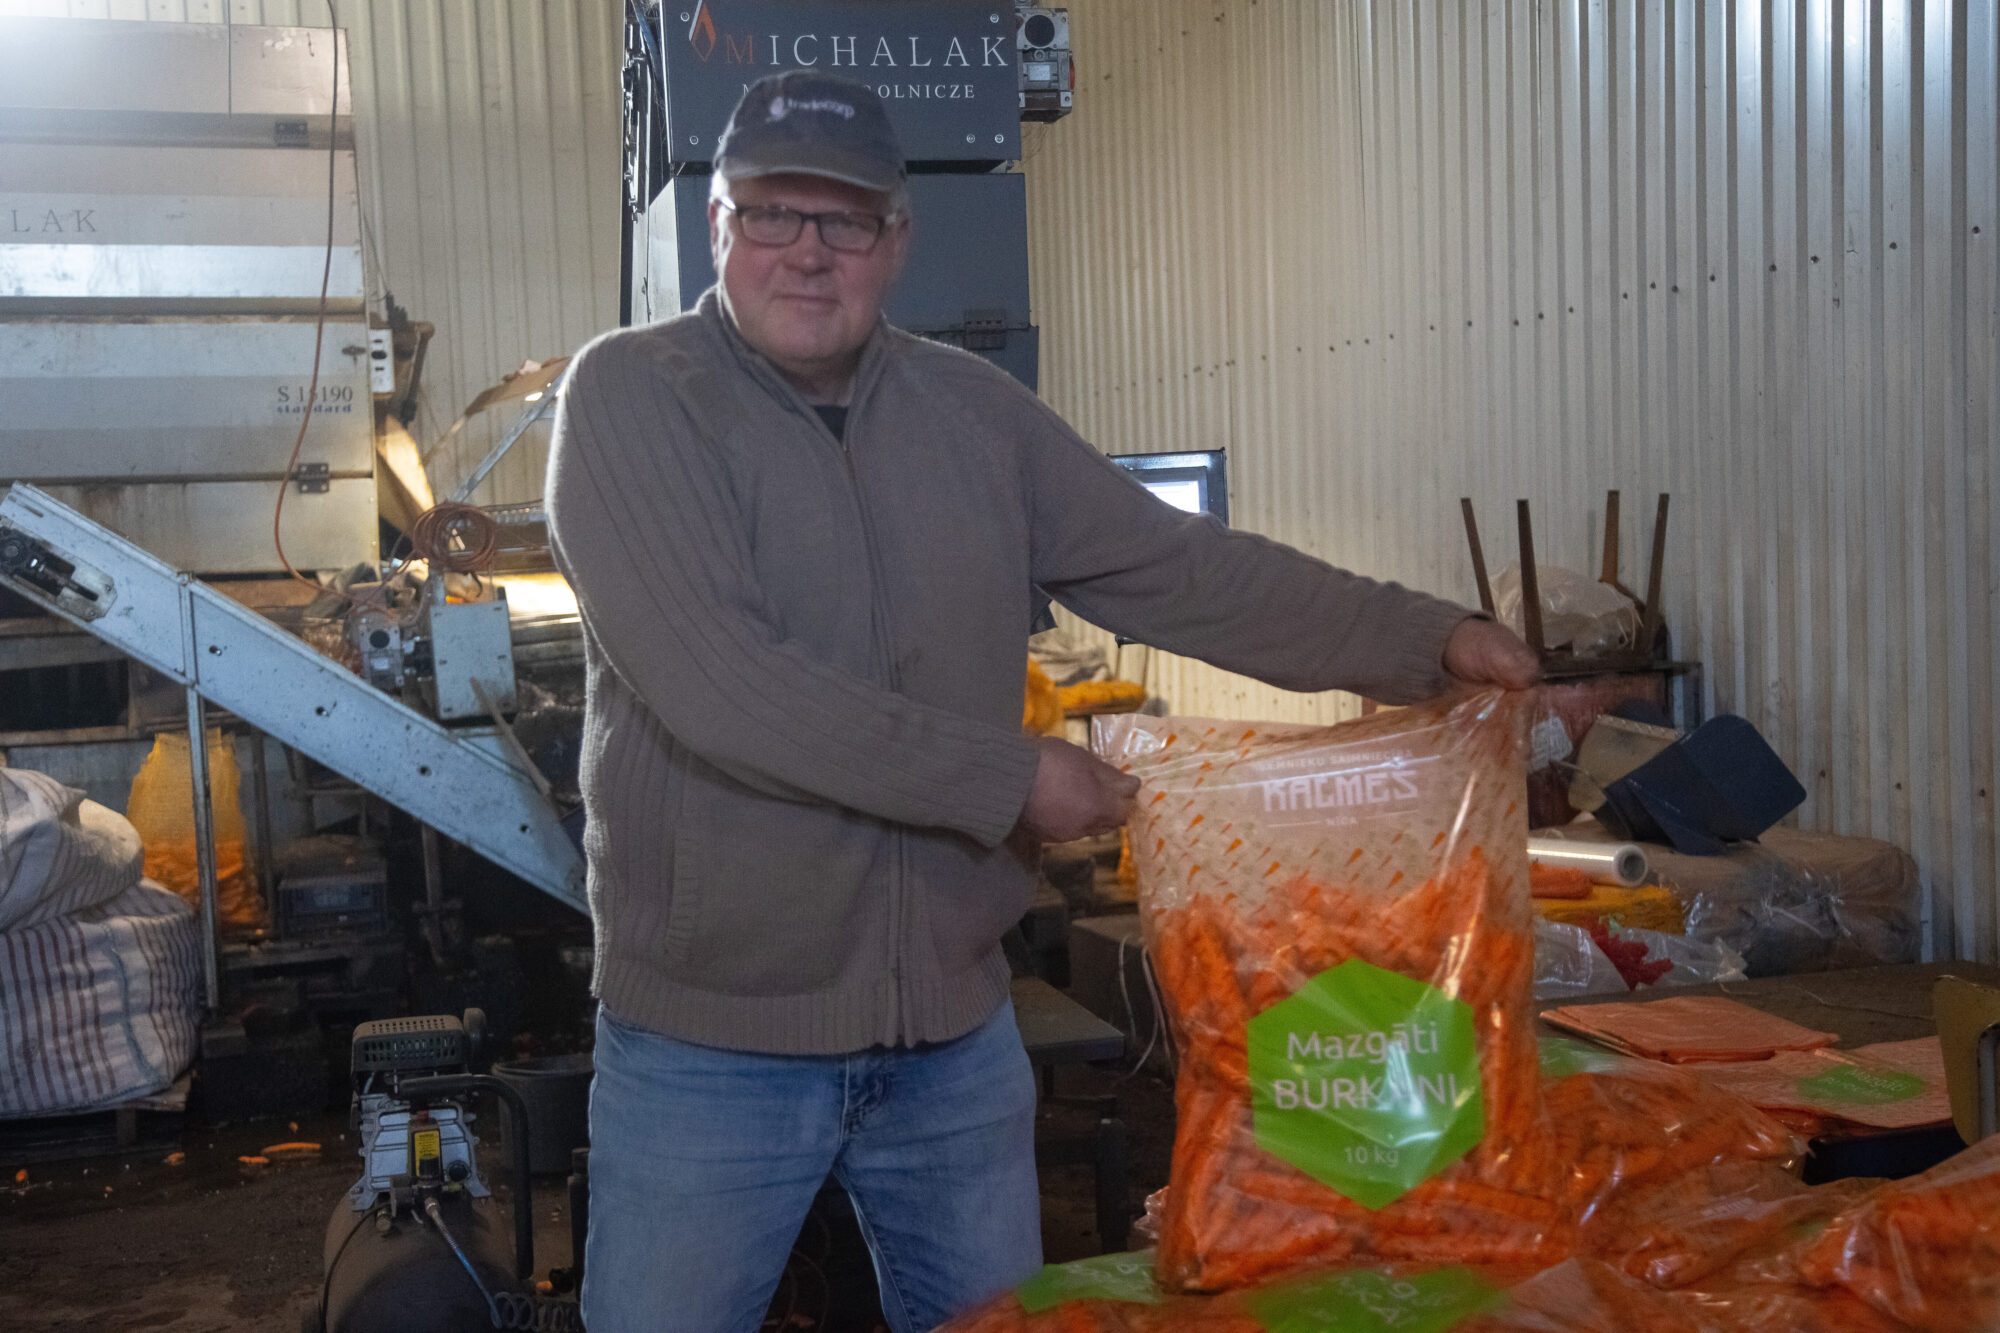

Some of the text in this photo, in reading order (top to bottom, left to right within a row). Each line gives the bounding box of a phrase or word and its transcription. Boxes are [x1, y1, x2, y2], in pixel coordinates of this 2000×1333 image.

[725, 34, 1008, 67] MICHALAK
[864, 84, 975, 99] OLNICZE
[1287, 1021, 1438, 1064] Mazgāti
[1344, 1146, 1399, 1168] 10 kg
